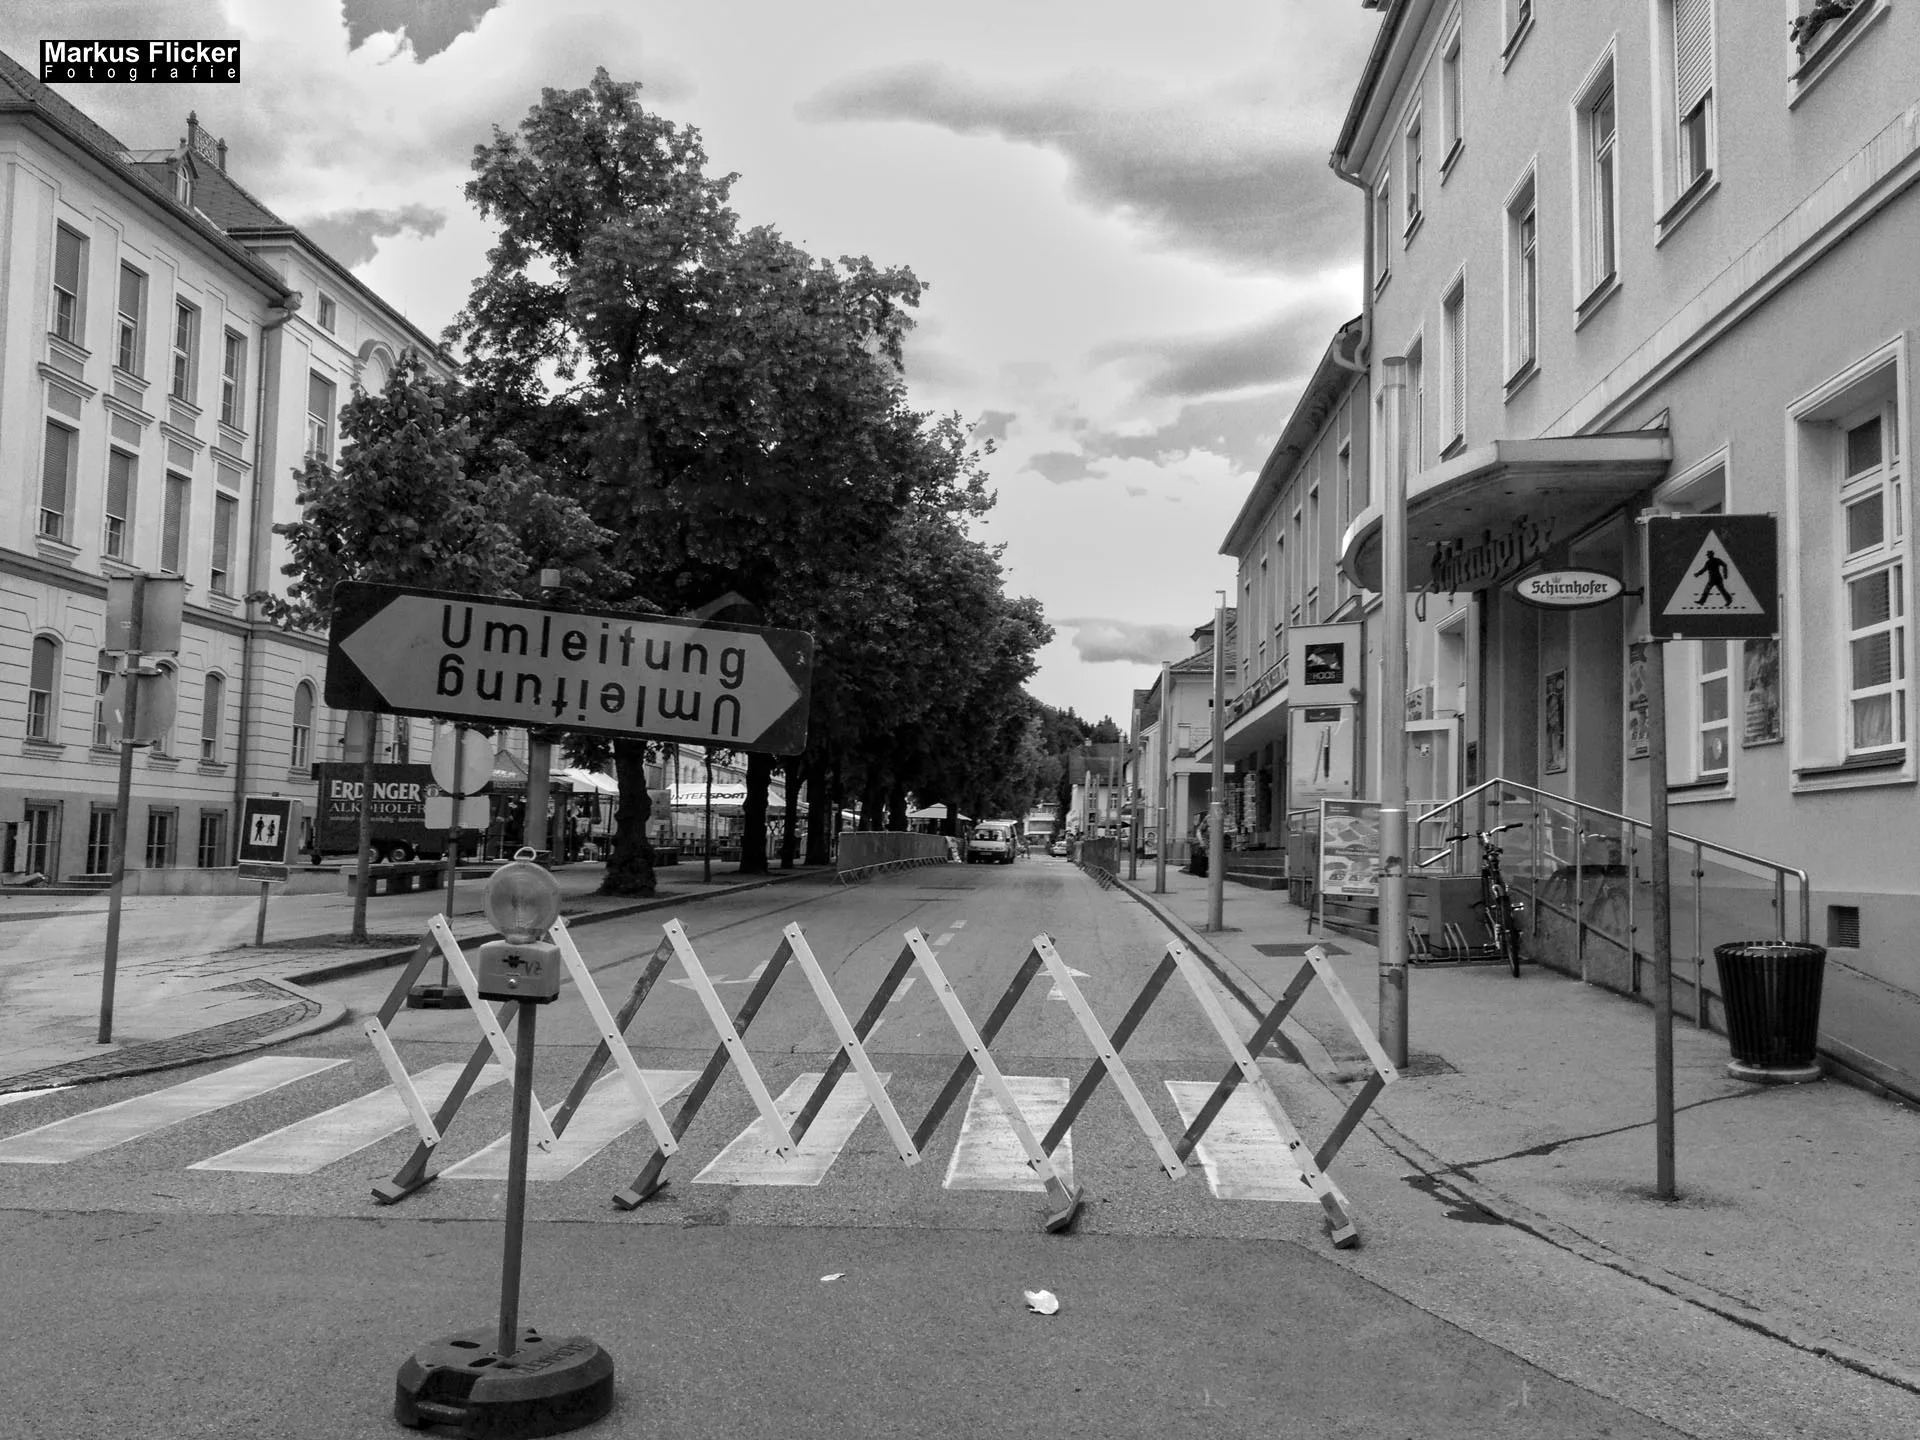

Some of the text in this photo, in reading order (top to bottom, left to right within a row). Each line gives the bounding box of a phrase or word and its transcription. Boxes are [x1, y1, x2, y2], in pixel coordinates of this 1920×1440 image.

[1531, 580, 1608, 596] Schirnhofer
[441, 604, 746, 690] Umleitung
[436, 653, 741, 737] Umleitung
[331, 780, 421, 802] ERDNGER
[329, 802, 425, 814] ALKHOLFR
